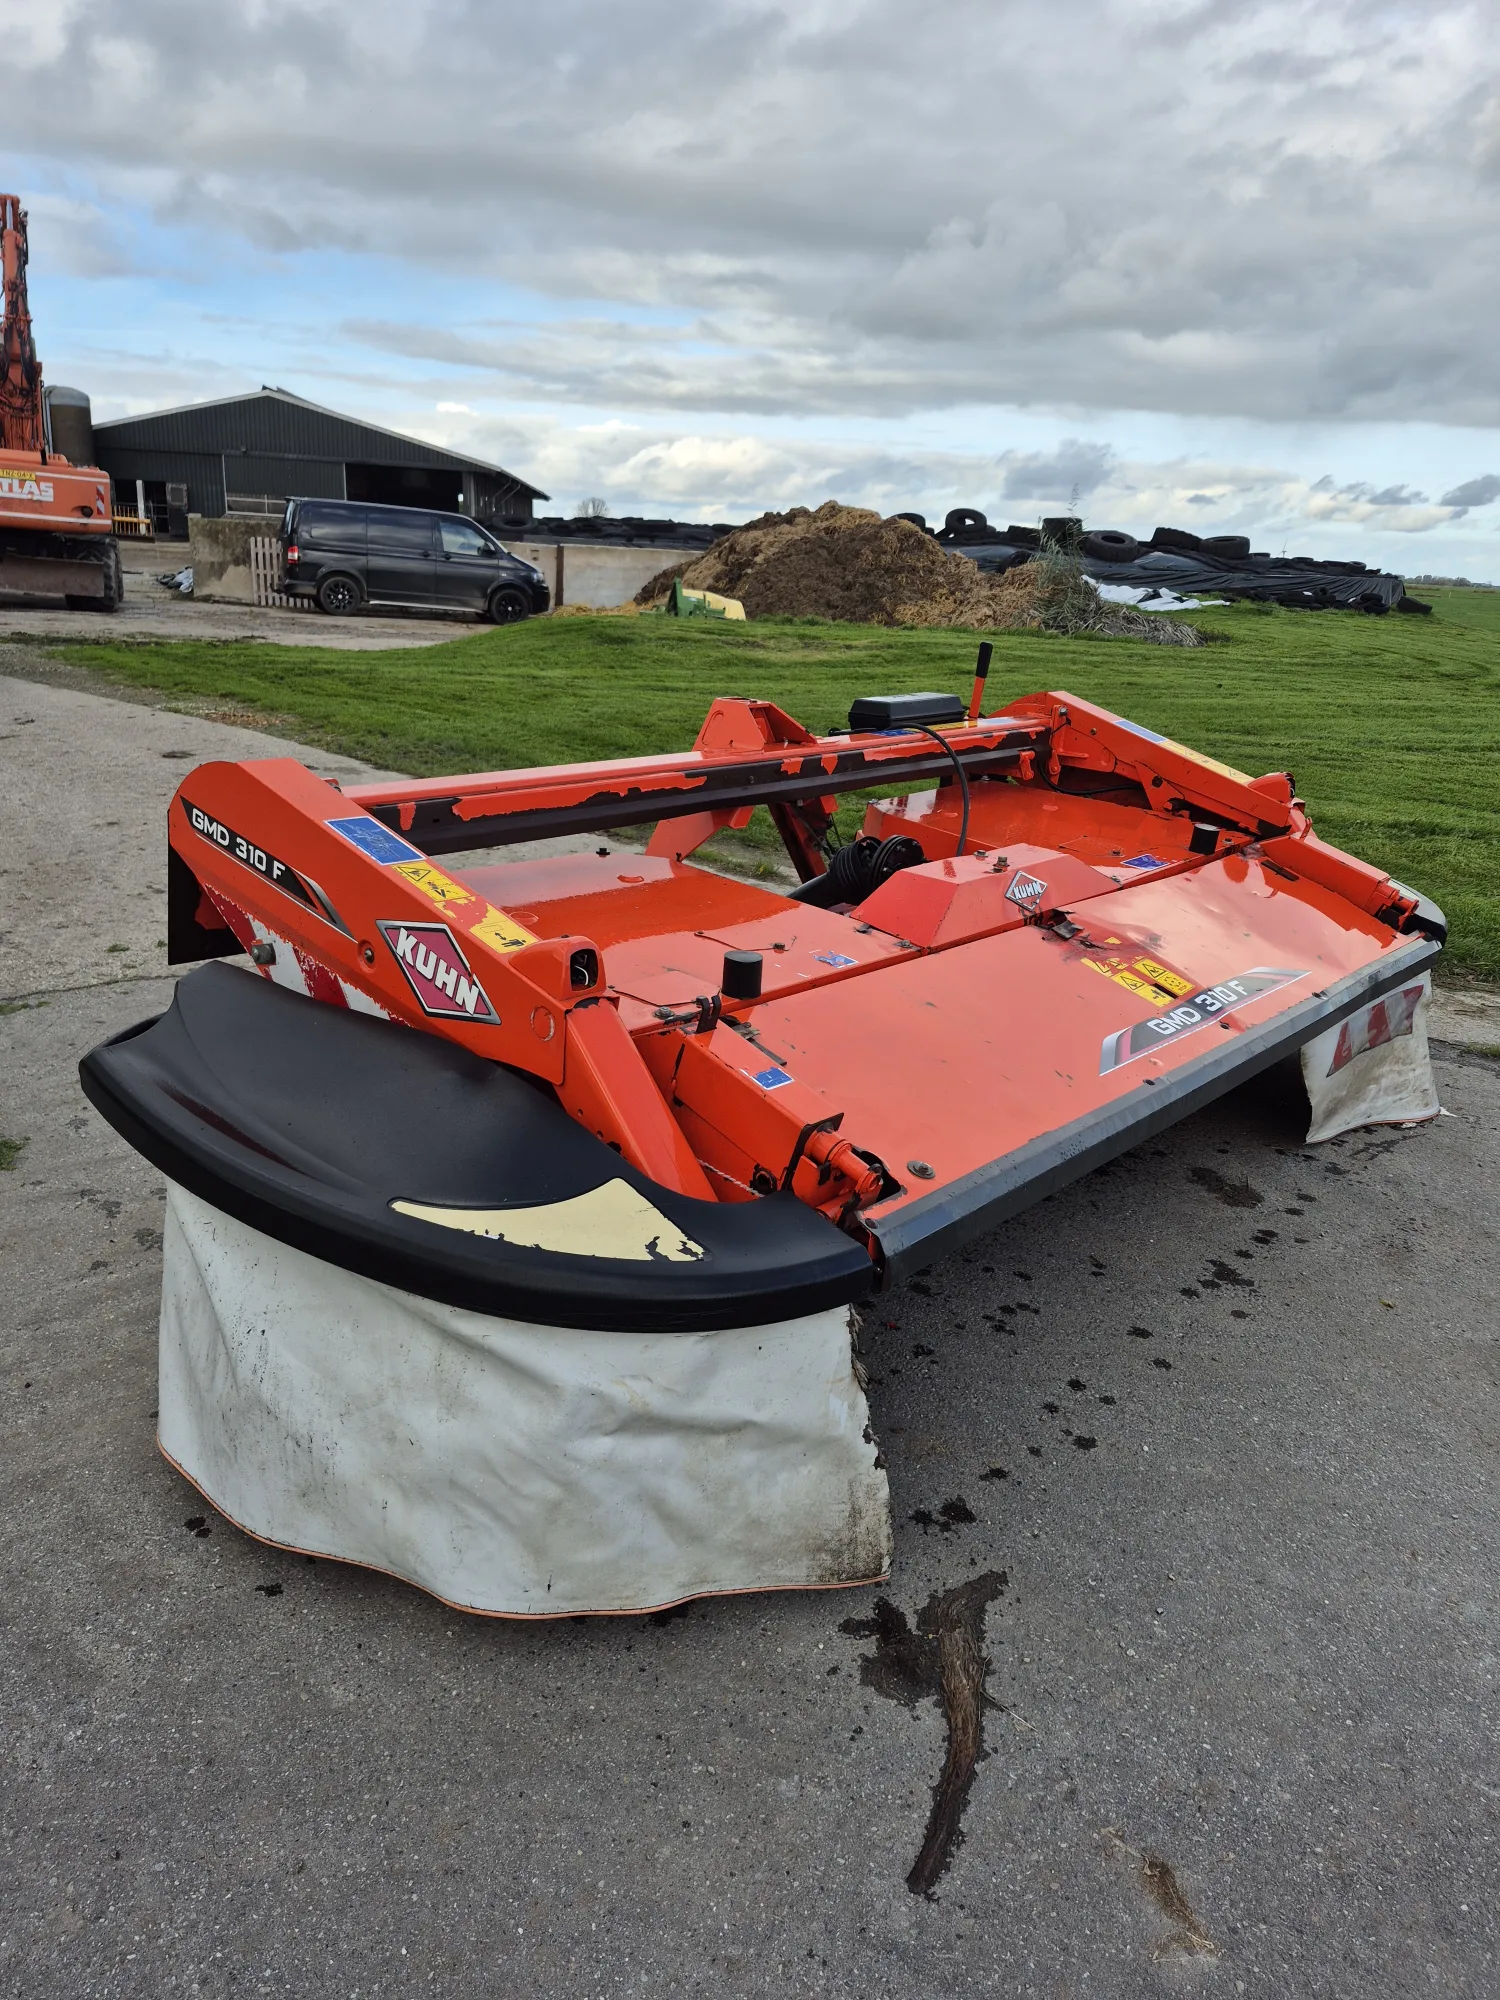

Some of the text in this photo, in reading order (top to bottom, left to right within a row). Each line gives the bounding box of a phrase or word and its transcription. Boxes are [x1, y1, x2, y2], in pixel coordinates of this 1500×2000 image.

[0, 477, 54, 501] TLAS
[192, 808, 286, 879] GMD 310 F
[1013, 880, 1042, 900] KUHN
[396, 926, 480, 1016] KUHN
[1146, 980, 1248, 1035] GMD 310 F
